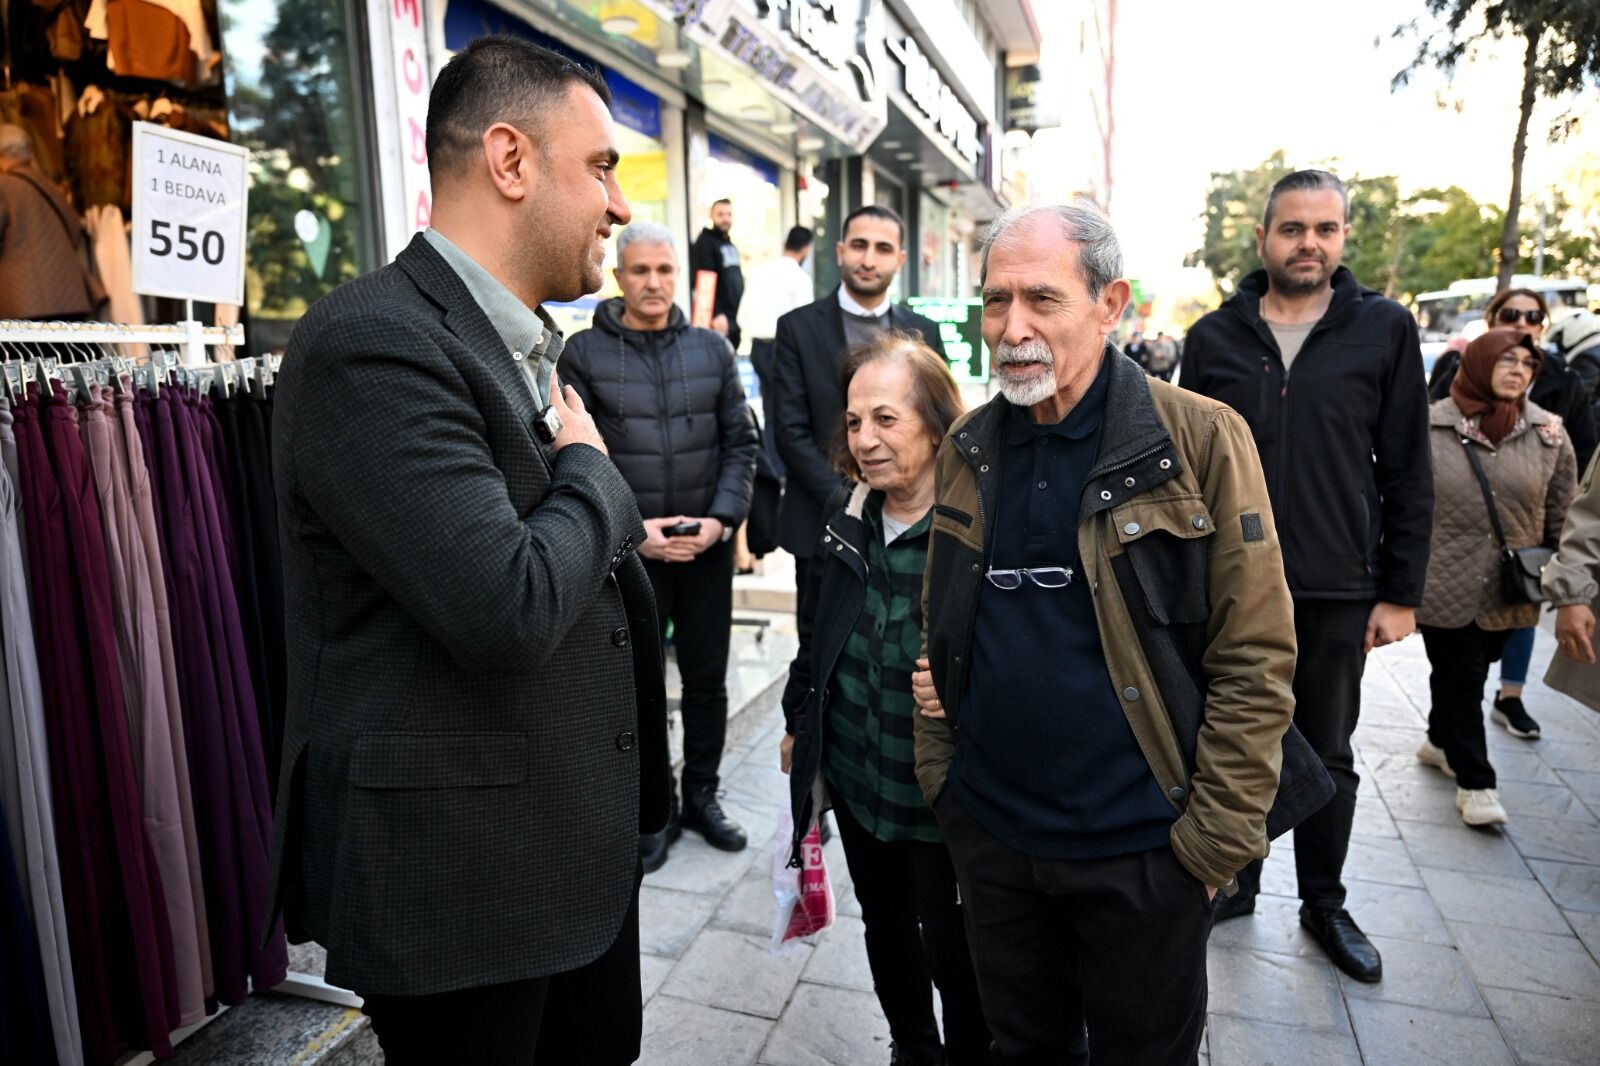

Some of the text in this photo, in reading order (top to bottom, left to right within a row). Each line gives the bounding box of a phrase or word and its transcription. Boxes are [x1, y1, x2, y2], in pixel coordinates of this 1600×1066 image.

[157, 149, 223, 176] 1 ALANA
[151, 177, 227, 206] 1 BEDAVA
[149, 219, 225, 265] 550
